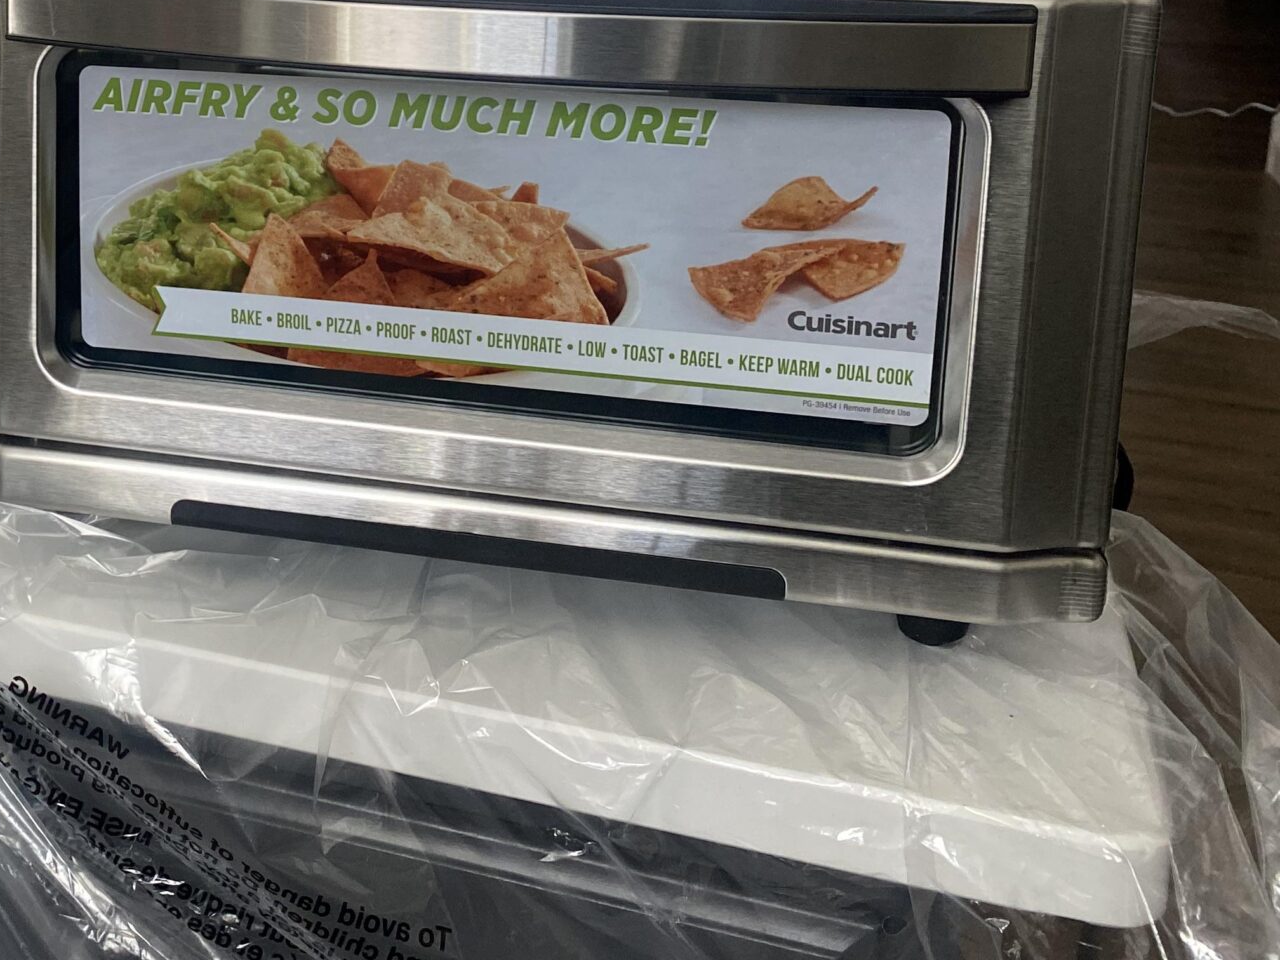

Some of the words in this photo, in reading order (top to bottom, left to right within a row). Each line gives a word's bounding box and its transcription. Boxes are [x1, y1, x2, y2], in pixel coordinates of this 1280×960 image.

[92, 77, 263, 119] AIRFRY
[269, 86, 300, 123] &
[312, 88, 377, 126] SO
[388, 92, 536, 136] MUCH
[545, 101, 718, 147] MORE!
[231, 308, 262, 326] BAKE
[277, 312, 311, 331] BROIL
[326, 317, 361, 335] PIZZA
[376, 321, 416, 340] PROOF
[431, 327, 472, 346] ROAST
[487, 331, 562, 354] DEHYDRATE
[578, 340, 606, 358] LOW
[622, 344, 664, 363] TOAST
[680, 349, 722, 369] BAGEL
[738, 354, 773, 373] KEEP
[777, 358, 820, 377] WARM
[837, 363, 872, 382] DUAL
[876, 367, 914, 386] COOK
[787, 310, 917, 341] Cuisinart
[843, 403, 871, 413] Remove
[873, 406, 896, 416] Before
[897, 408, 911, 417] Use
